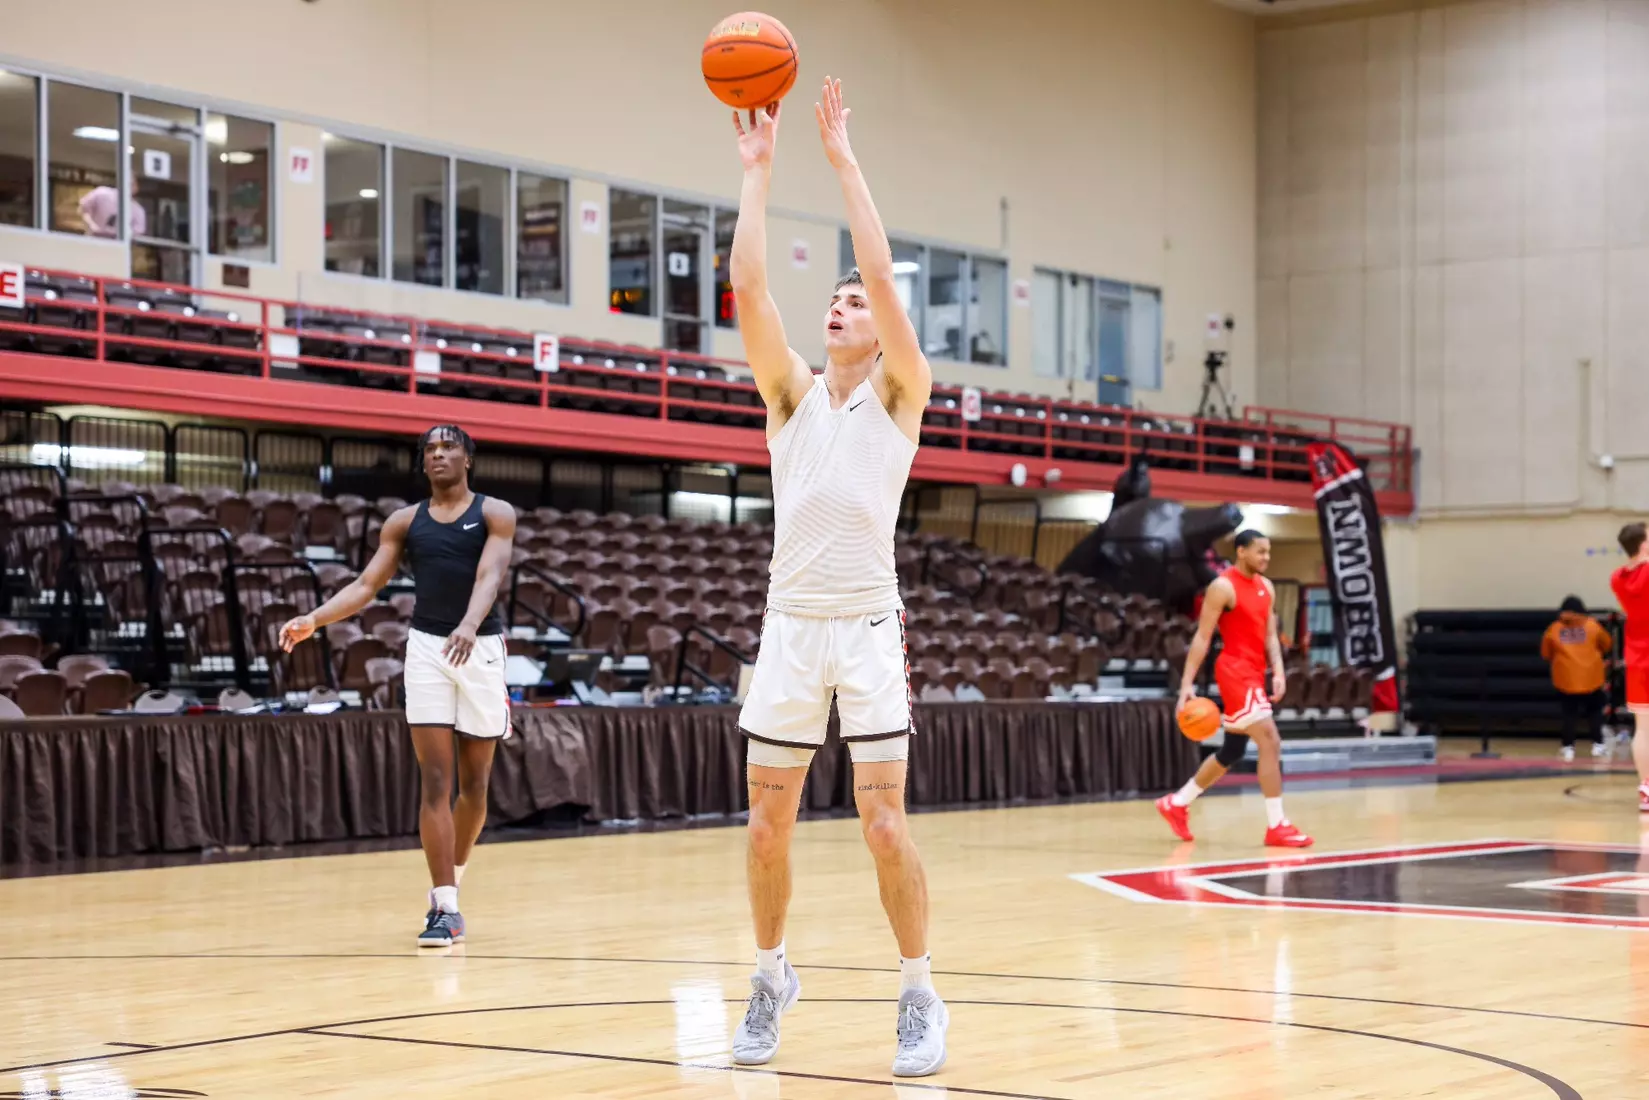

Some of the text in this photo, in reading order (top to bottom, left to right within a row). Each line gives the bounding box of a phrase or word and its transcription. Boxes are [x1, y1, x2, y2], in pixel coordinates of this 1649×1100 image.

[0, 271, 18, 298] E
[540, 341, 553, 363] F
[762, 780, 770, 789] is
[771, 783, 785, 791] the
